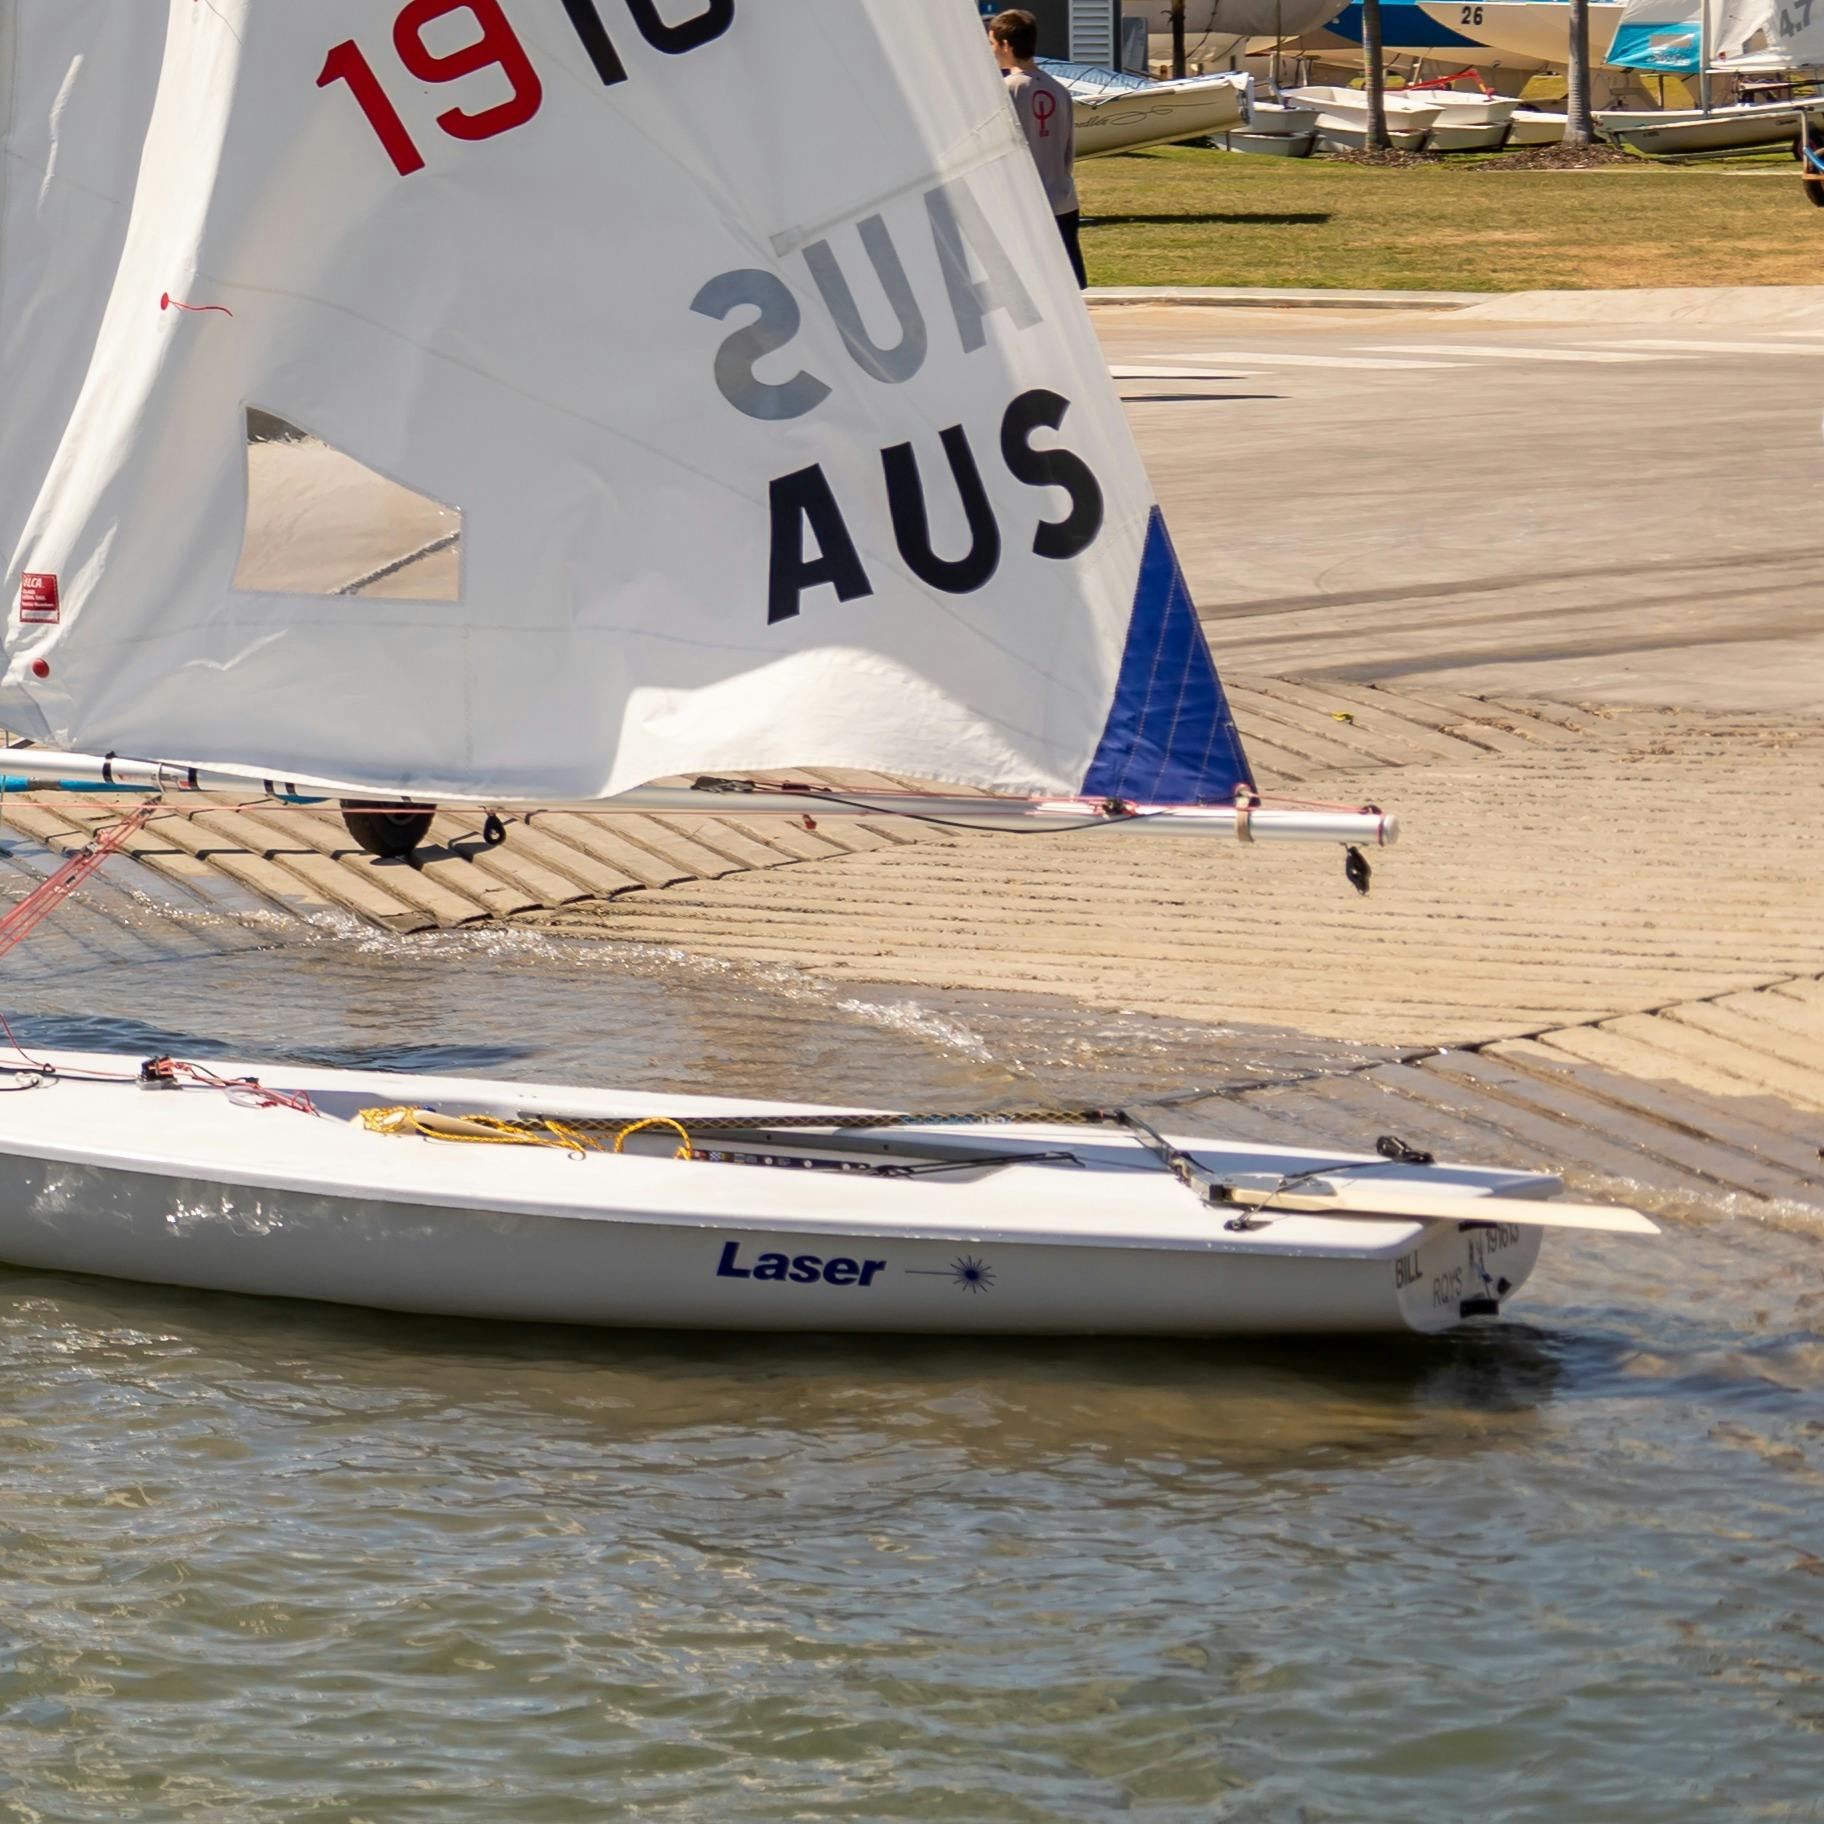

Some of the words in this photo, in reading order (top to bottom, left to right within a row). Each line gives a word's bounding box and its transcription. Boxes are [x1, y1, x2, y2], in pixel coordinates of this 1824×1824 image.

[1461, 6, 1483, 25] 26
[766, 388, 1104, 626] AUS
[716, 1241, 887, 1287] Laser
[1395, 1248, 1424, 1289] BILL
